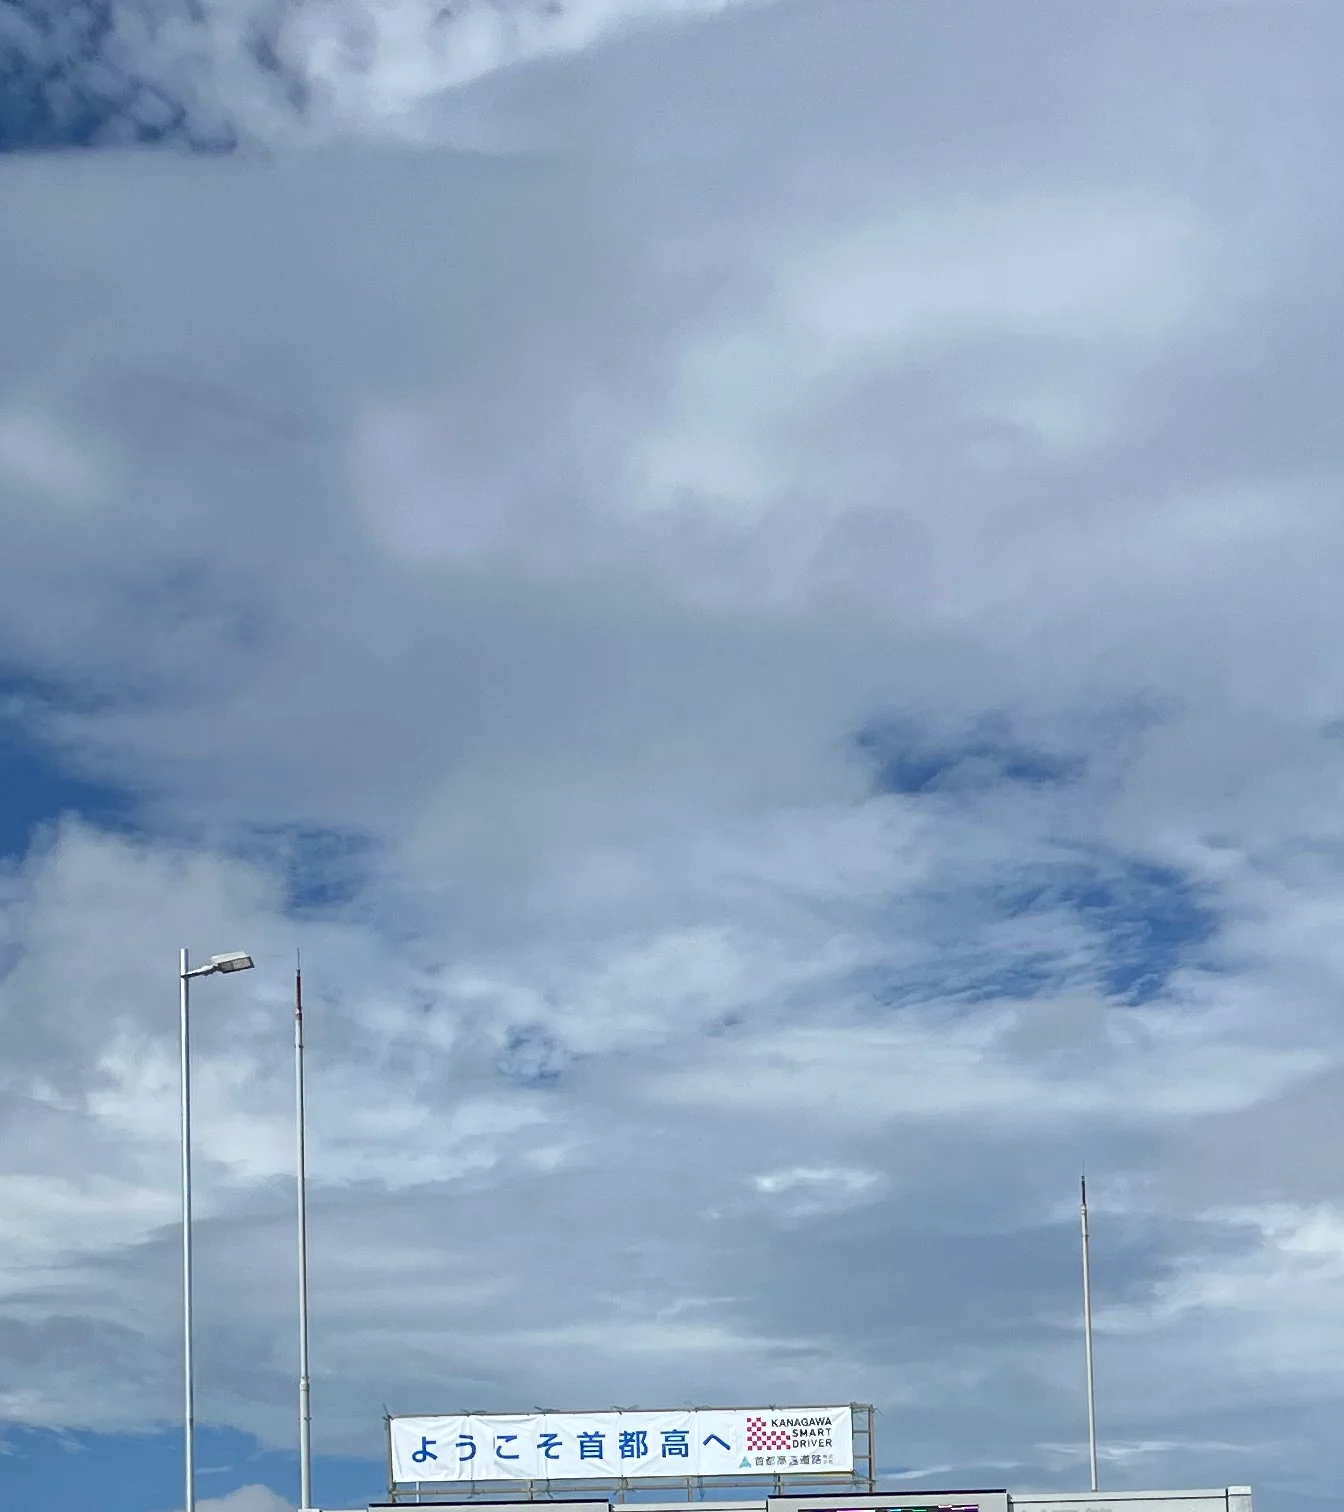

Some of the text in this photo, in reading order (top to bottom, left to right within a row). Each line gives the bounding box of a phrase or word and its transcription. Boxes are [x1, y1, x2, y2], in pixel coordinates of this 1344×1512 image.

[771, 1417, 832, 1427] KANAGAWA
[792, 1428, 832, 1437] SMART
[411, 1428, 732, 1463] ようこそ首都高へ
[792, 1439, 832, 1448] DRIVER
